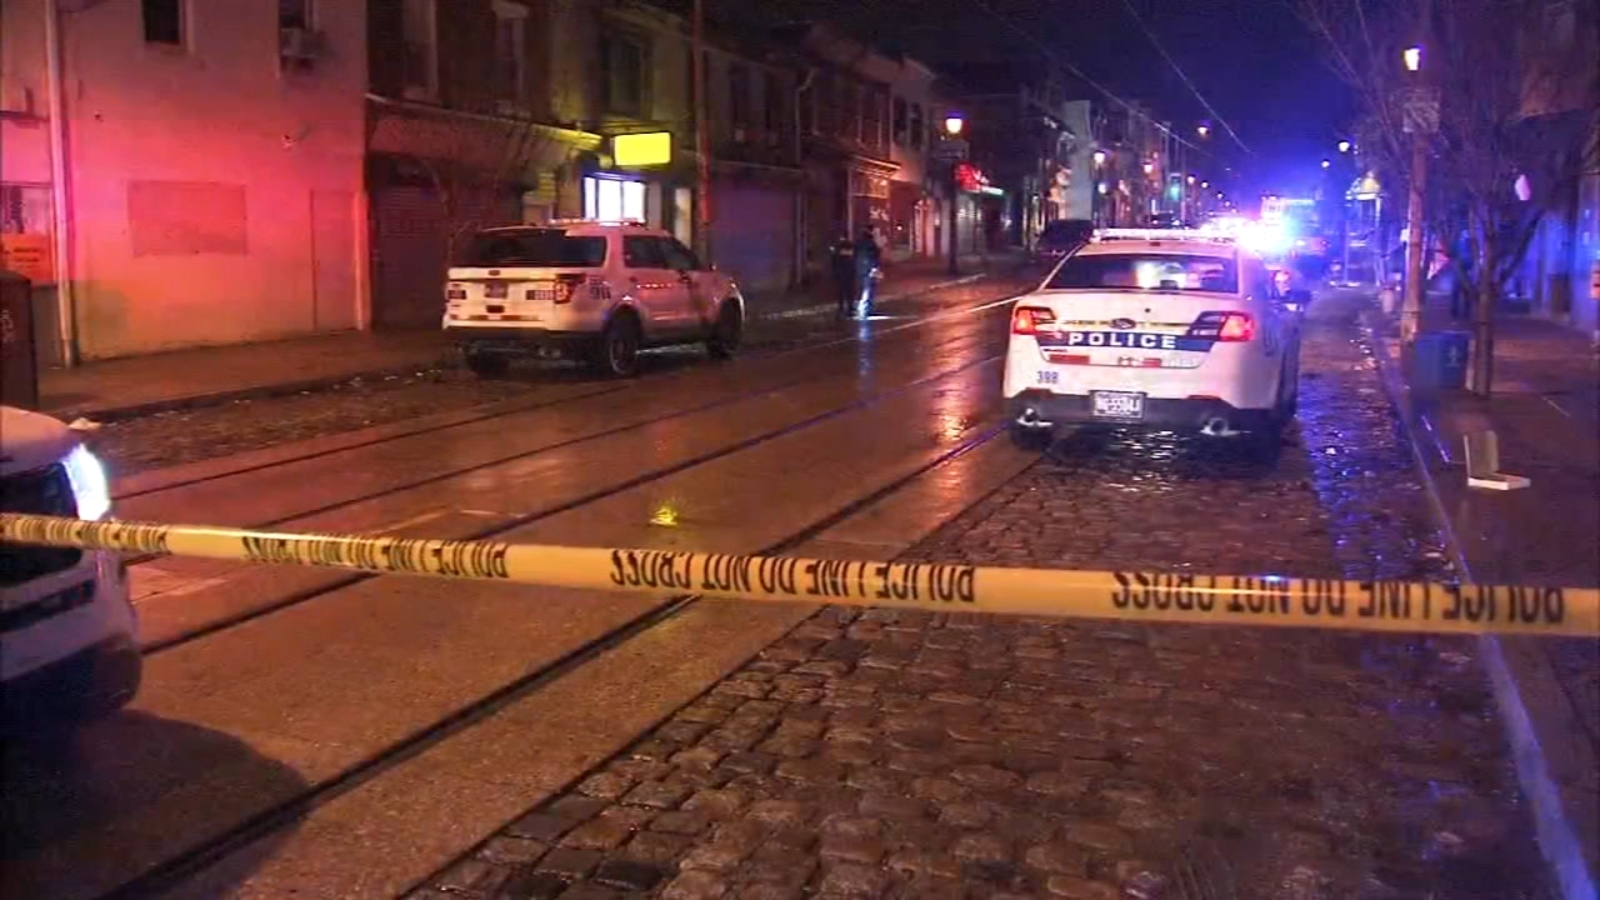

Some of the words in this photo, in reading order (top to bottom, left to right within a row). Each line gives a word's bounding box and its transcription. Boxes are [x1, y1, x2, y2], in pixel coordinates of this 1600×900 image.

[1068, 331, 1177, 349] POLICE
[610, 548, 697, 589] CROSS
[702, 552, 752, 593] NOT
[758, 554, 797, 595] DO
[805, 556, 867, 599] LINE
[875, 560, 976, 603] POLICE
[1111, 571, 1217, 613] CROSS
[1226, 575, 1290, 614] NOT
[1302, 577, 1346, 616] DO
[1358, 580, 1430, 619] LINE
[1442, 584, 1565, 624] POLICE
